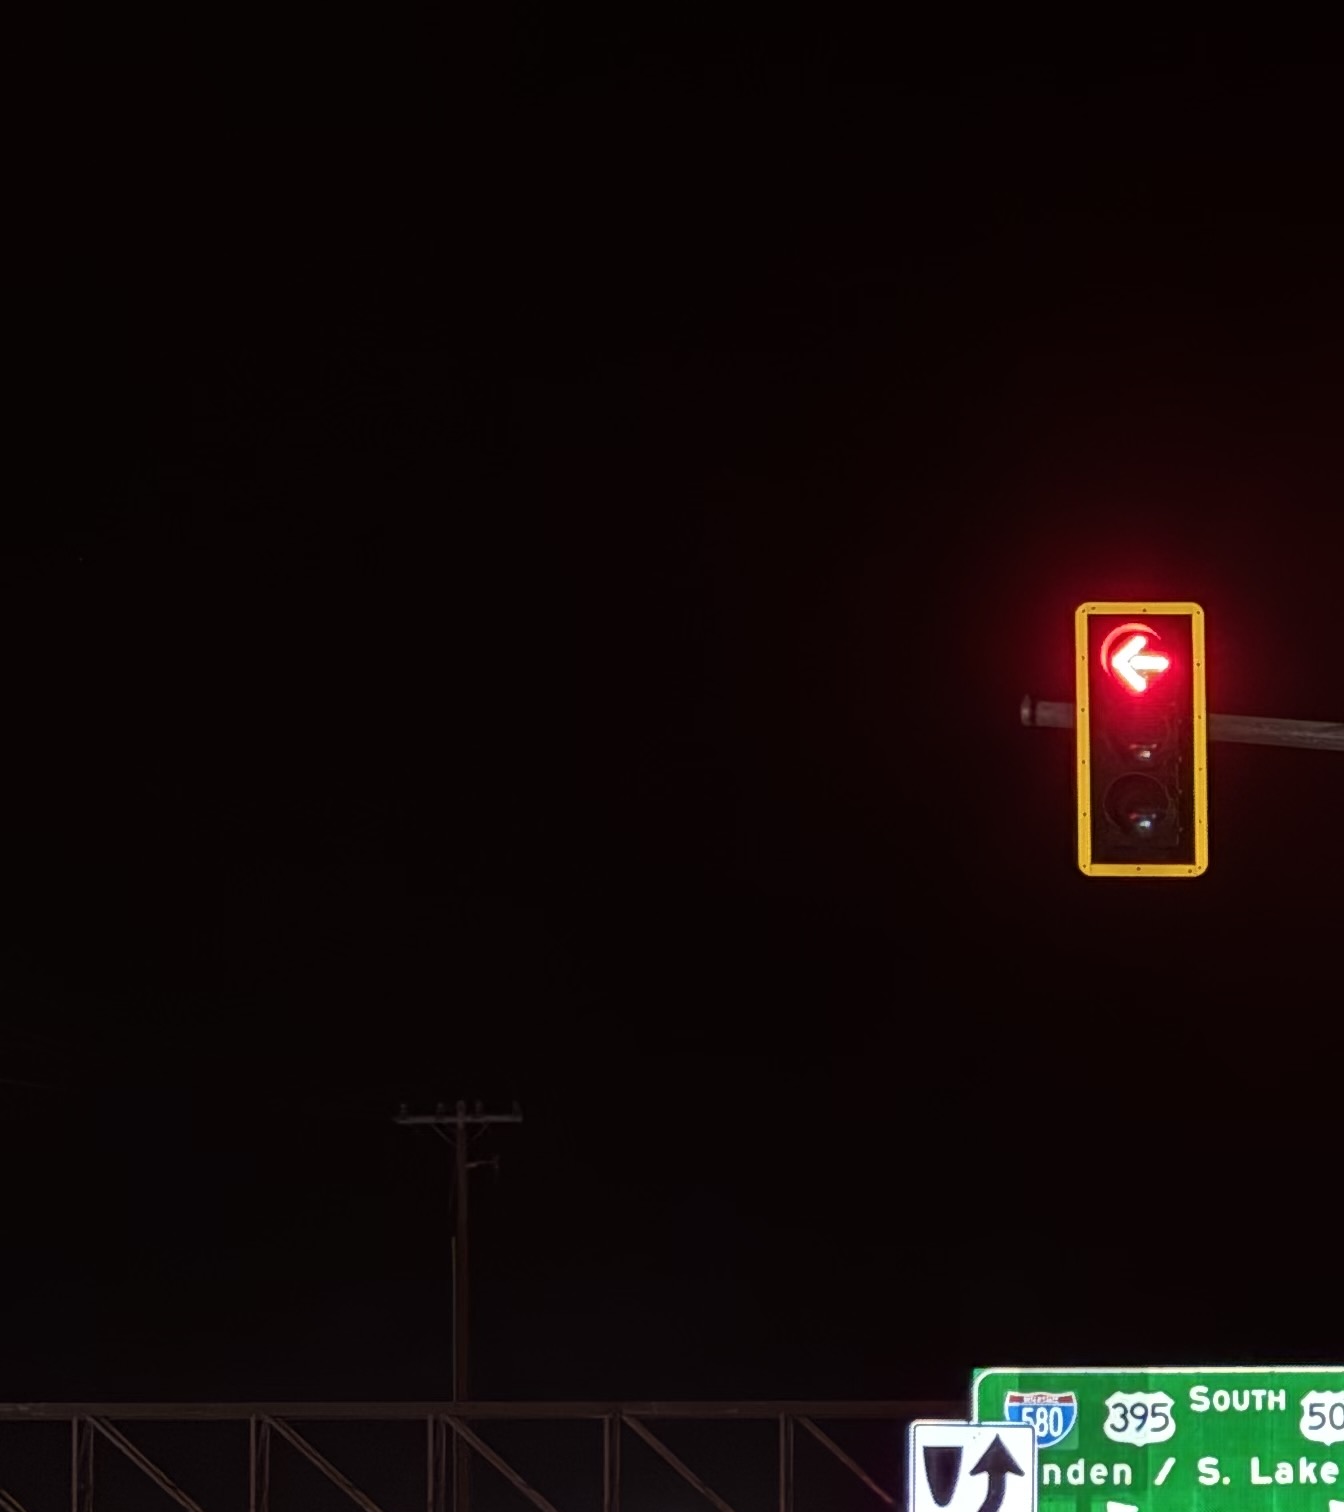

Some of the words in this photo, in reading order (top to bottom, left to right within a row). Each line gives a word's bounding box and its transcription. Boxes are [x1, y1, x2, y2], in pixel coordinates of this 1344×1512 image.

[1020, 1405, 1064, 1439] 580
[1108, 1401, 1171, 1434] 395
[1188, 1385, 1286, 1413] SOUTH
[1042, 1458, 1132, 1486] nden
[1197, 1456, 1231, 1486] S.
[1250, 1456, 1340, 1485] Lake
